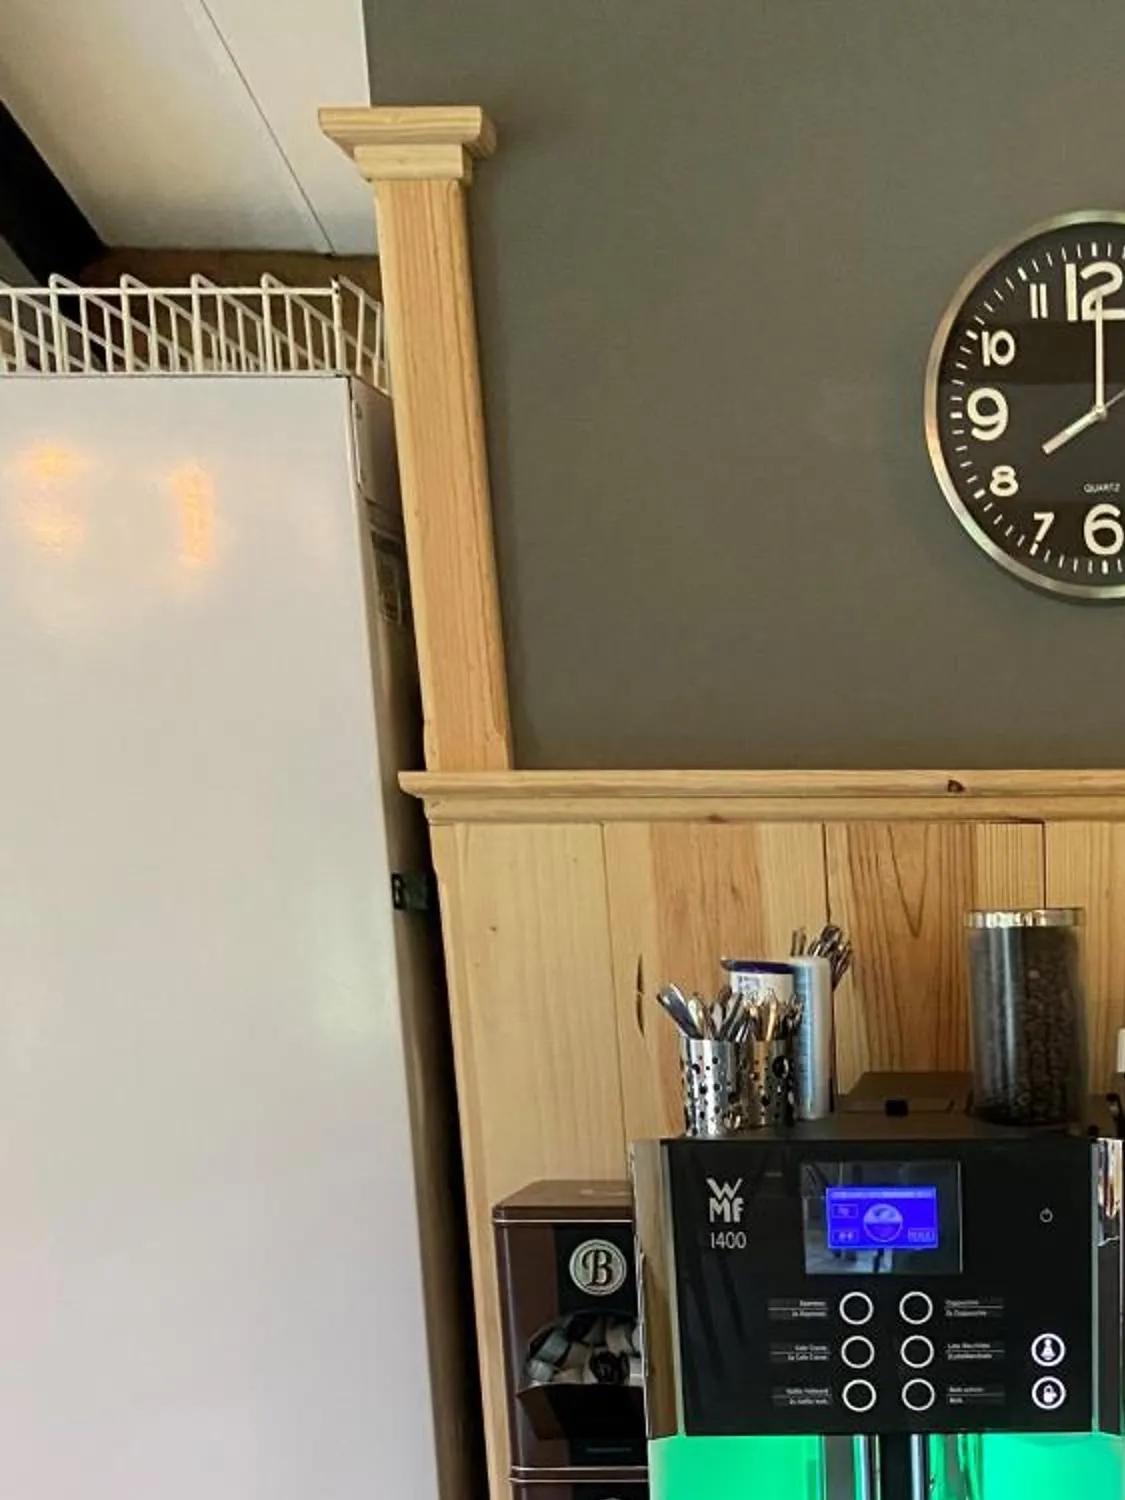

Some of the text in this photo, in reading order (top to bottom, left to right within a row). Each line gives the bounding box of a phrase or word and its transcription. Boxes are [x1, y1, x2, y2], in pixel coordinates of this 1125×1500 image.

[1029, 283, 1048, 319] 11
[981, 329, 1016, 367] 10
[966, 387, 1009, 441] 9
[989, 465, 1019, 497] 8
[1083, 482, 1121, 493] QUARTZ
[1033, 511, 1055, 543] 7
[1082, 503, 1125, 555] 6
[710, 1231, 747, 1249] 1400
